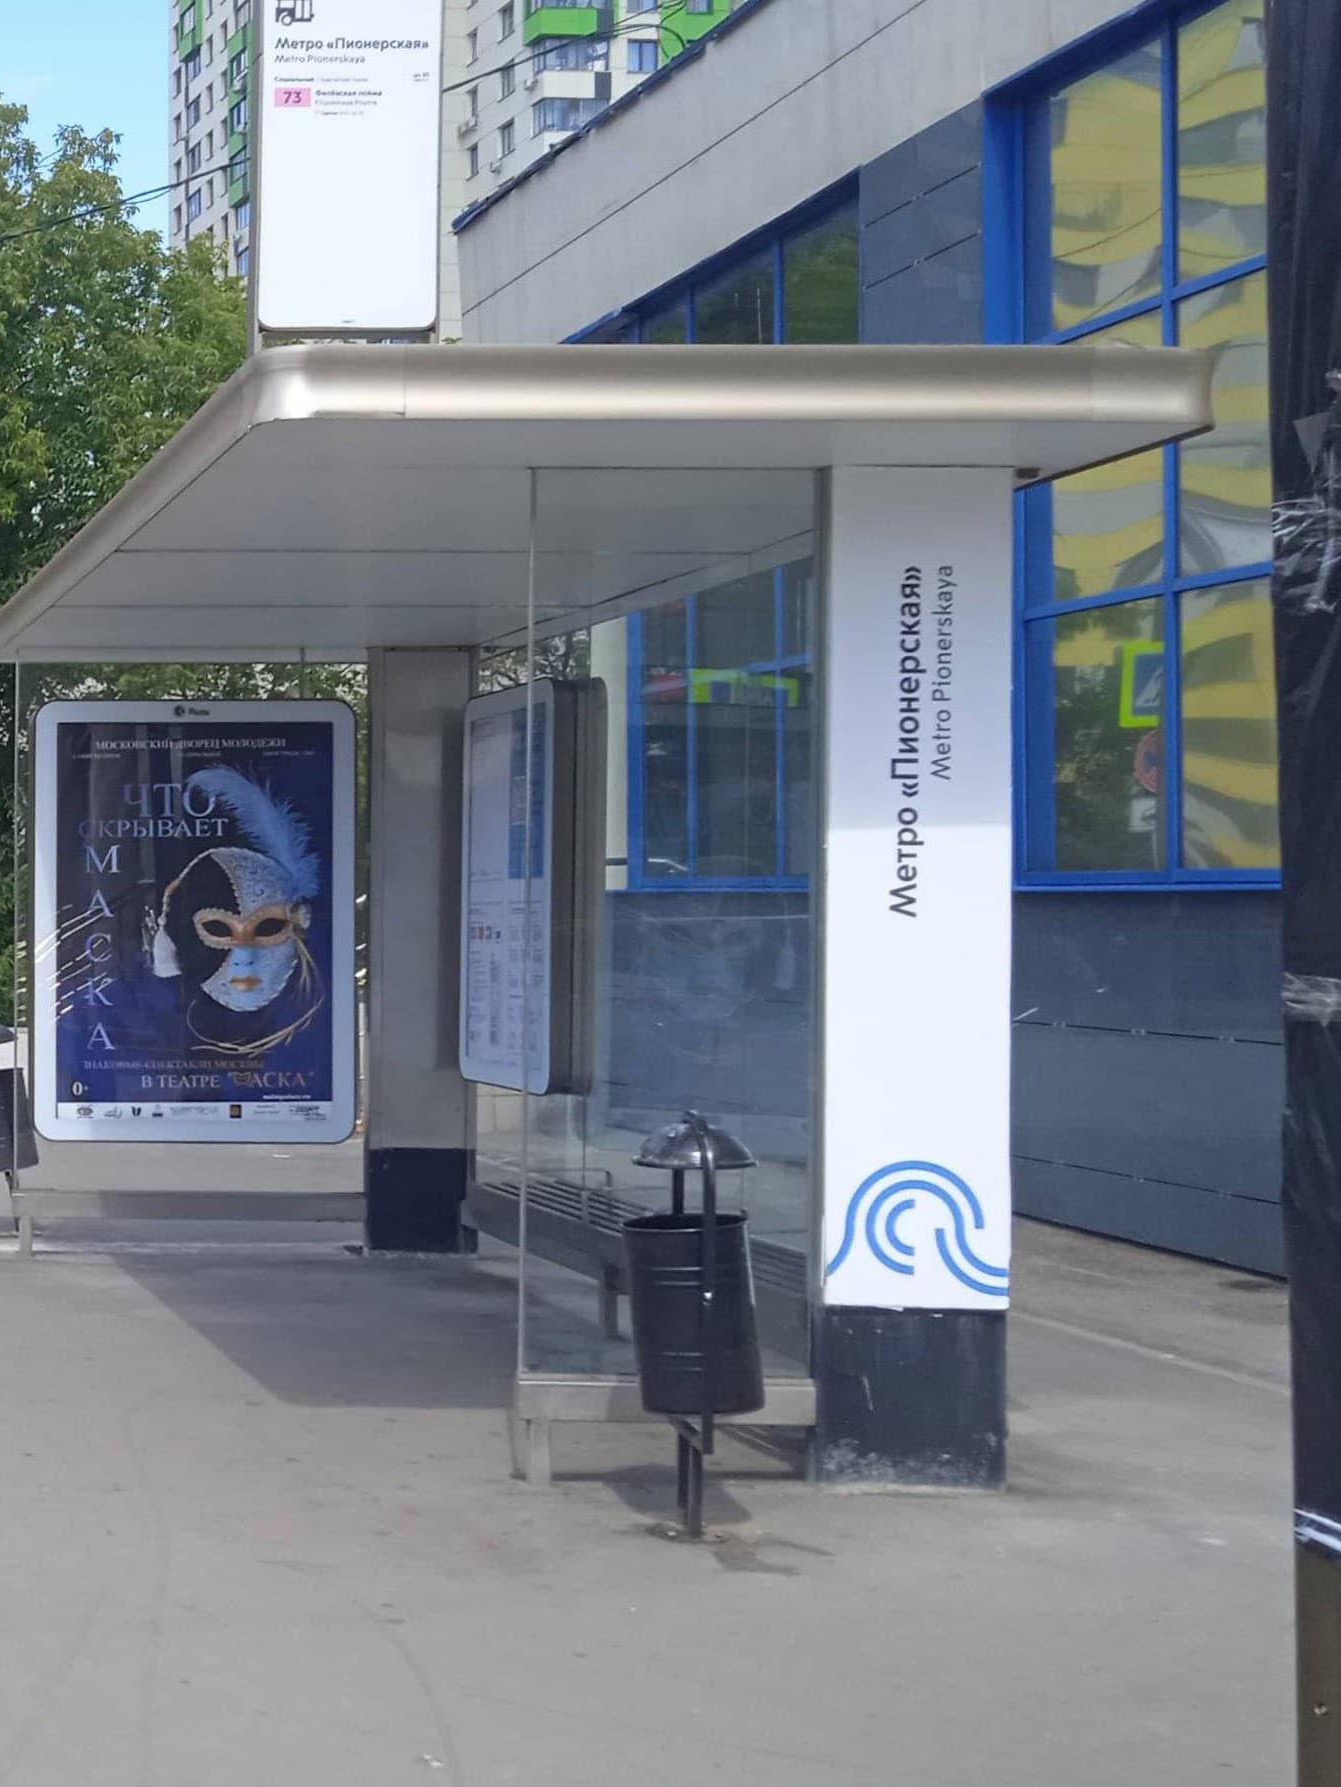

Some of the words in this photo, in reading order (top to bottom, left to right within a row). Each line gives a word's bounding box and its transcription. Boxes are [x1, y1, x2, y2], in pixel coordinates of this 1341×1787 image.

[274, 37, 323, 51] Метро
[327, 37, 429, 51] «Пионерская»
[274, 55, 305, 63] Metro
[307, 54, 366, 64] Pionerskaya
[283, 91, 302, 104] 73
[931, 564, 958, 701] Pionerskaya
[891, 565, 927, 799] «Пионерская»
[931, 709, 952, 780] Metro
[122, 783, 217, 818] ЧТО
[78, 818, 229, 838] СКРЫВАЕТ
[889, 806, 925, 918] Метро
[141, 1074, 153, 1089] В
[156, 1073, 221, 1089] ТЕАТРЕ
